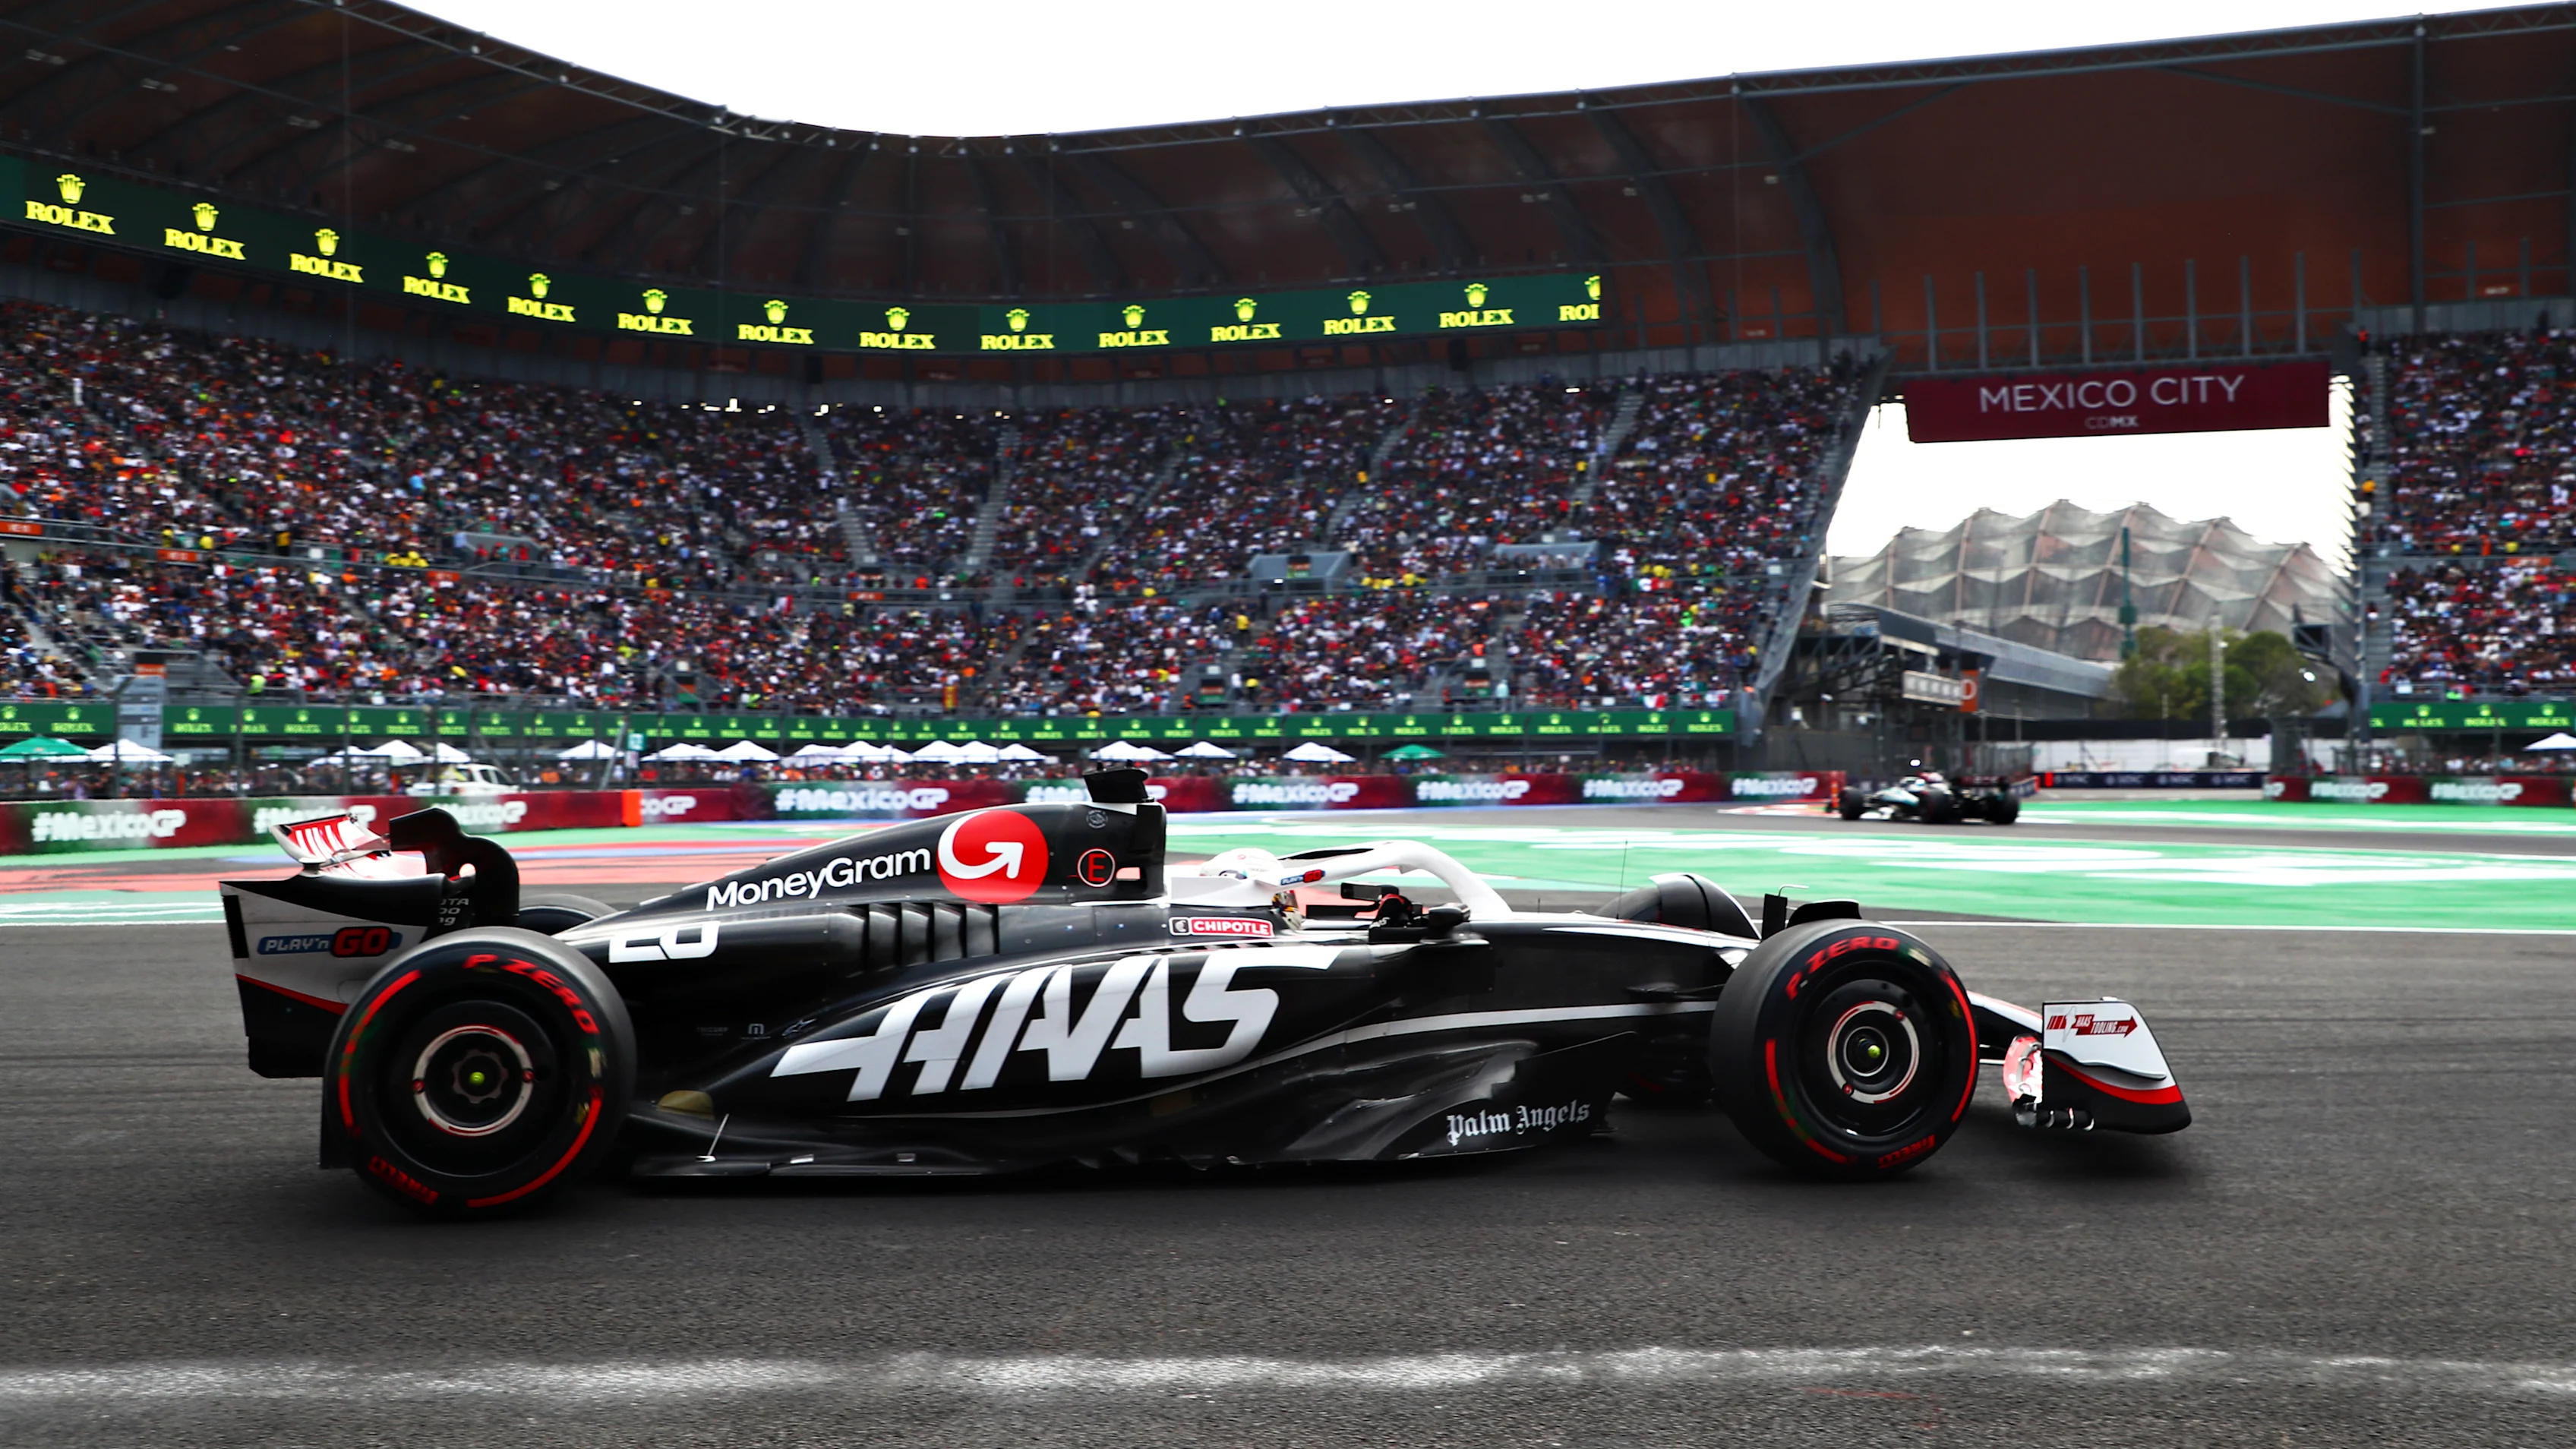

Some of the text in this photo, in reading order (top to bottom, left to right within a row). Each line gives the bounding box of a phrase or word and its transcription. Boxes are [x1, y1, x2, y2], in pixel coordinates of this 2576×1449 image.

[26, 200, 115, 235] ROLEX
[165, 229, 245, 260] ROLEX
[290, 253, 364, 283] ROLEX
[403, 276, 470, 304] ROLEX
[508, 296, 576, 322] ROLEX
[1439, 308, 1514, 328] ROLEX
[617, 313, 693, 335] ROLEX
[737, 324, 814, 345] ROLEX
[1211, 323, 1281, 342] ROLEX
[1324, 316, 1396, 335] ROLEX
[860, 332, 936, 349] ROLEX
[980, 334, 1055, 350] ROLEX
[1099, 330, 1170, 348] ROLEX
[1979, 374, 2245, 413] MEXICO CITY
[2084, 415, 2140, 429] CDMX
[775, 788, 949, 812] #MexicoGP
[1232, 782, 1359, 803] #MexicoGP
[1416, 780, 1530, 800] #MexicoGP
[31, 809, 187, 842] #MexicoGP
[706, 847, 931, 911] MoneyGram
[1087, 853, 1106, 882] E
[1194, 919, 1271, 936] CHIPOTLE
[333, 927, 390, 956] GO
[1805, 936, 1901, 974] ZERO
[462, 953, 601, 1035] P ZERO
[769, 945, 1340, 1102] HAAS
[1446, 1099, 1591, 1147] Palm Angels
